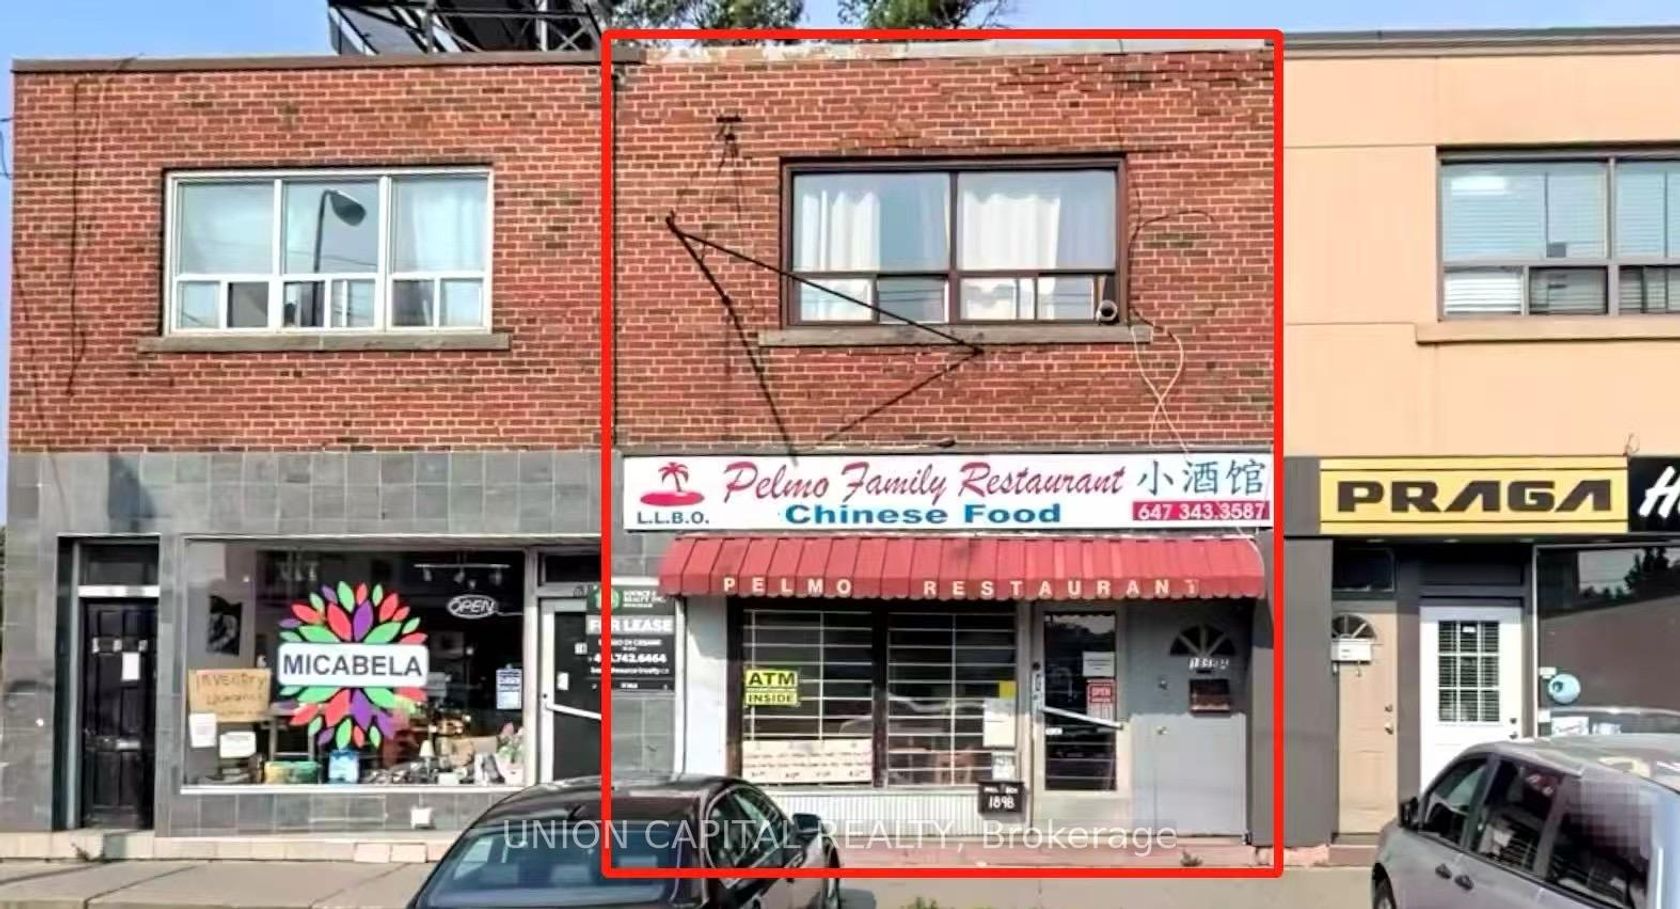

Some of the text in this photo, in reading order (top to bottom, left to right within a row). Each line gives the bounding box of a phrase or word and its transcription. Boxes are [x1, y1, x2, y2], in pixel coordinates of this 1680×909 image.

[723, 461, 1126, 505] Pelmo Family Restaurant
[1137, 458, 1266, 496] 小酒馆
[1337, 479, 1611, 513] PRAGA
[637, 511, 709, 525] L.L.B.O.
[785, 503, 1061, 524] Chinese Food
[1138, 502, 1265, 519] 647 343.3587
[723, 577, 1199, 597] PELMO RESTAURANT
[449, 598, 495, 614] OPEN
[624, 619, 672, 632] LEASE
[283, 653, 423, 677] MICABELA
[749, 672, 795, 685] ATM
[748, 694, 794, 702] INSIDE
